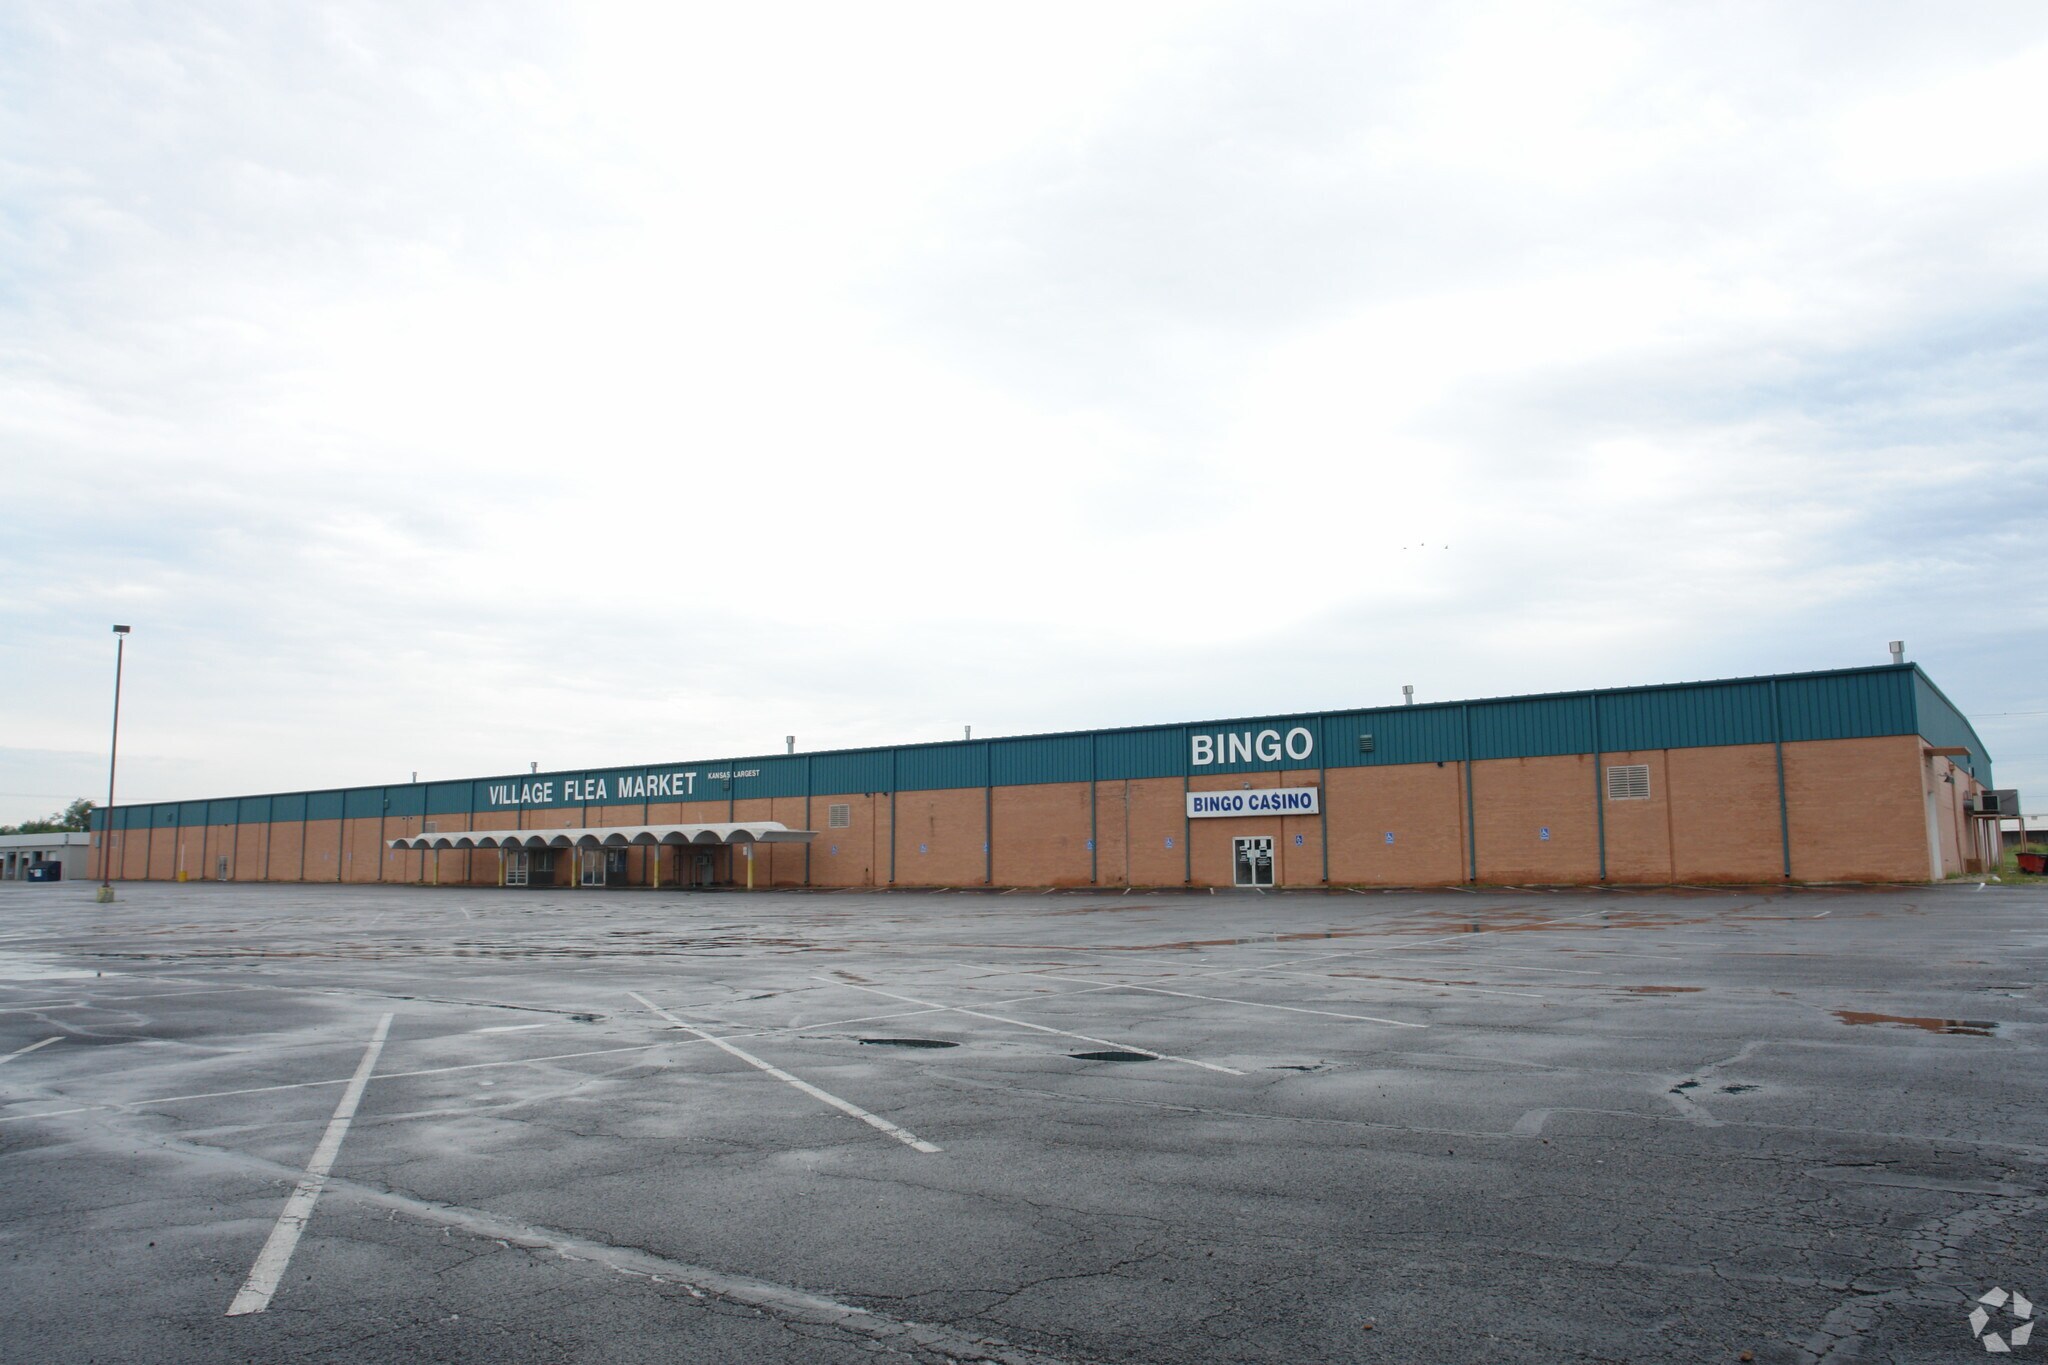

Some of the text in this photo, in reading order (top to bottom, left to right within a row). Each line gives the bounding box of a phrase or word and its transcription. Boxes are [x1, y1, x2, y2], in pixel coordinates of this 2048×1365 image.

[1191, 727, 1314, 766] BINGO
[707, 769, 760, 780] KANSAS LARGEST
[489, 772, 697, 805] VILLAGE FLEA MARKET
[1193, 795, 1243, 813] BINGO
